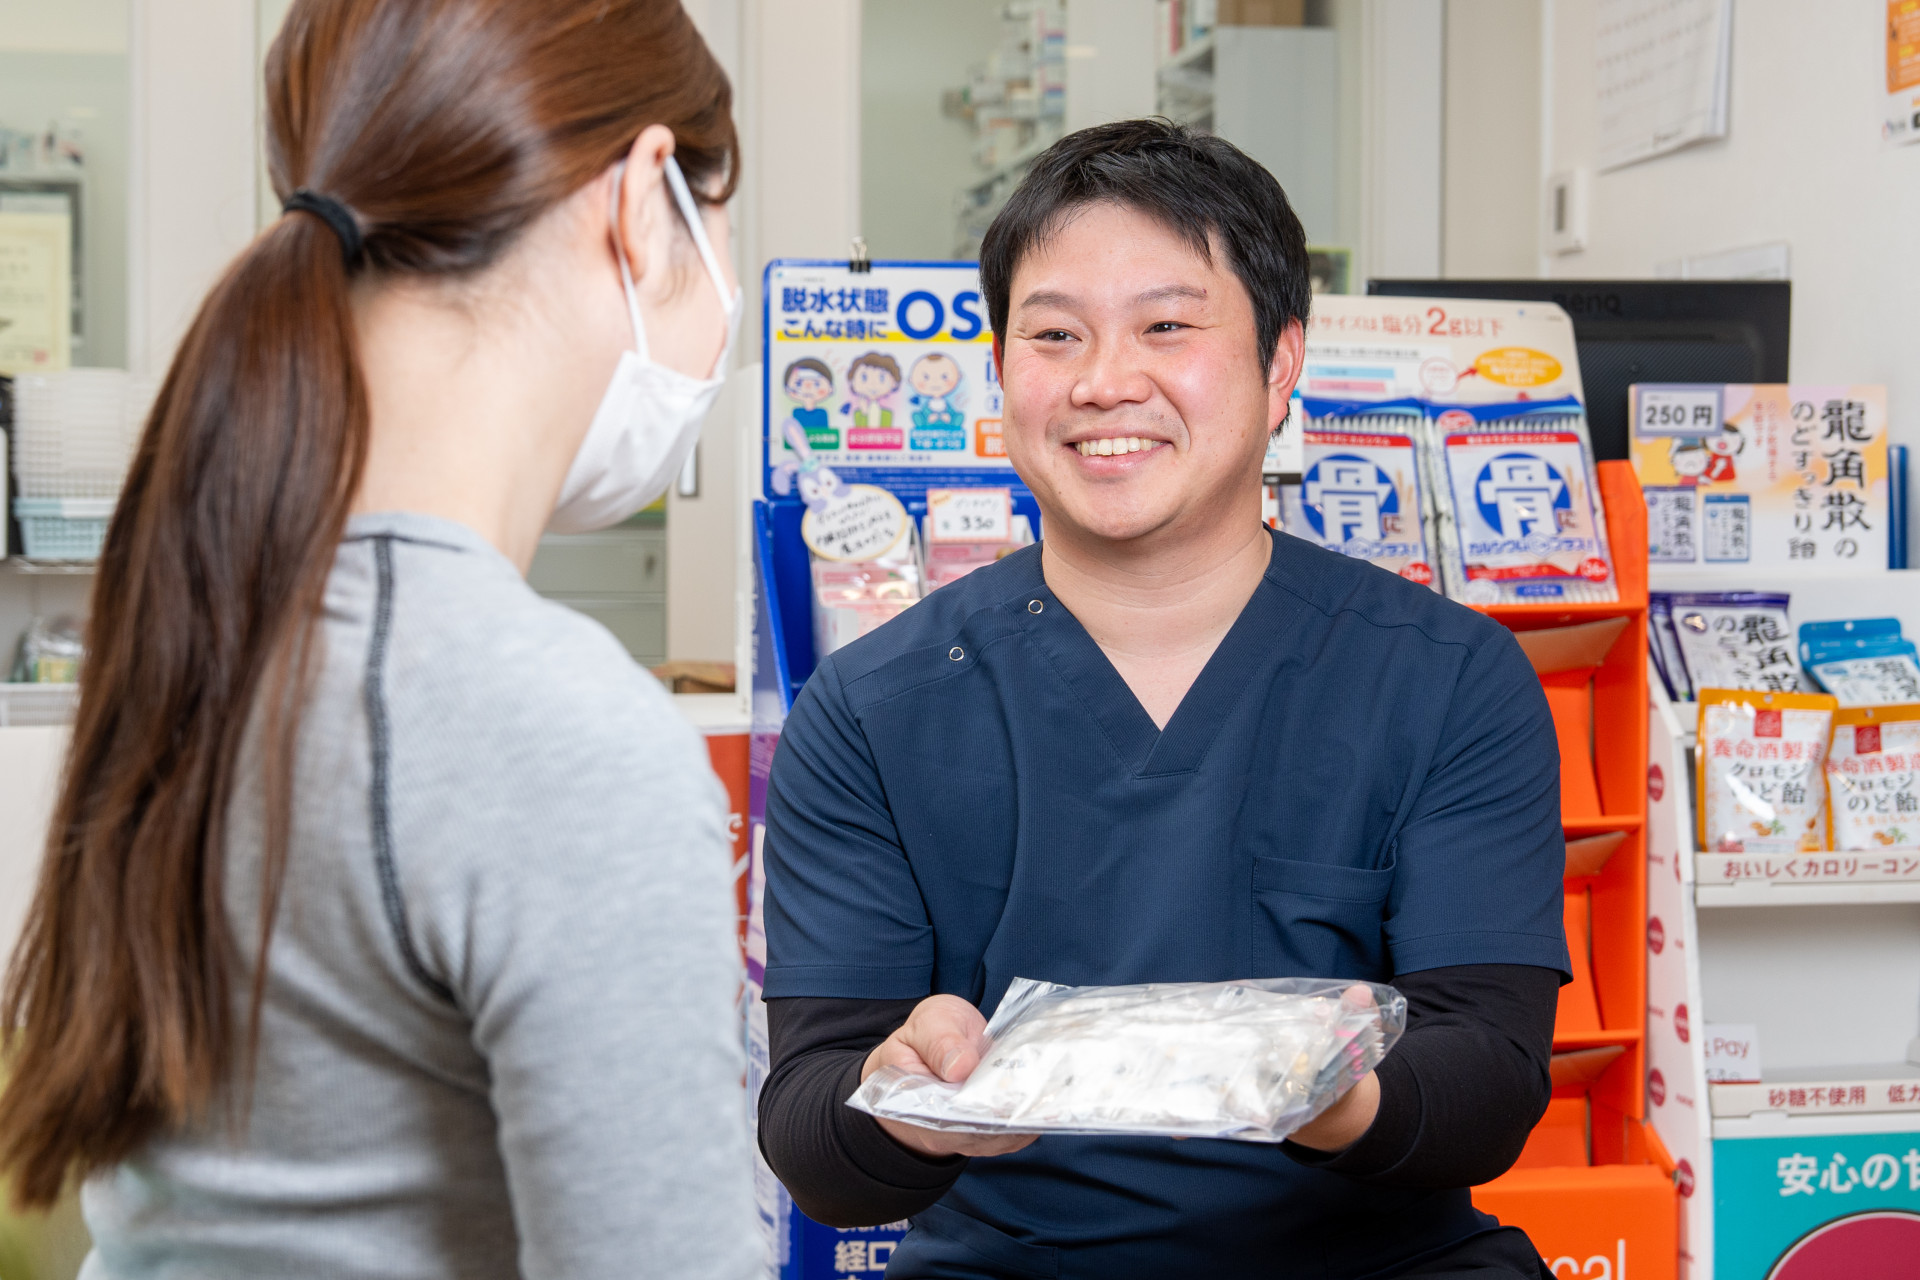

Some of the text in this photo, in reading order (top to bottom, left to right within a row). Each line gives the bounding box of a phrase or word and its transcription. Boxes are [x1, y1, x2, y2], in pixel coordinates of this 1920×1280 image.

[781, 286, 889, 314] 脱水状態
[896, 290, 983, 340] OS
[783, 318, 888, 340] こんな時に
[1646, 405, 1712, 426] 250 円
[1788, 401, 1817, 560] のどすっきり飴
[1820, 399, 1873, 559] 龍角散の
[1712, 737, 1826, 761] 養命酒製造
[1730, 761, 1809, 780] クロモジ
[1847, 792, 1919, 814] のど飴
[1723, 857, 1920, 880] おいしくカロリーコン
[1768, 1085, 1866, 1108] 砂糖不使用
[834, 1239, 897, 1274] 経口
[1543, 1238, 1626, 1280] cal
